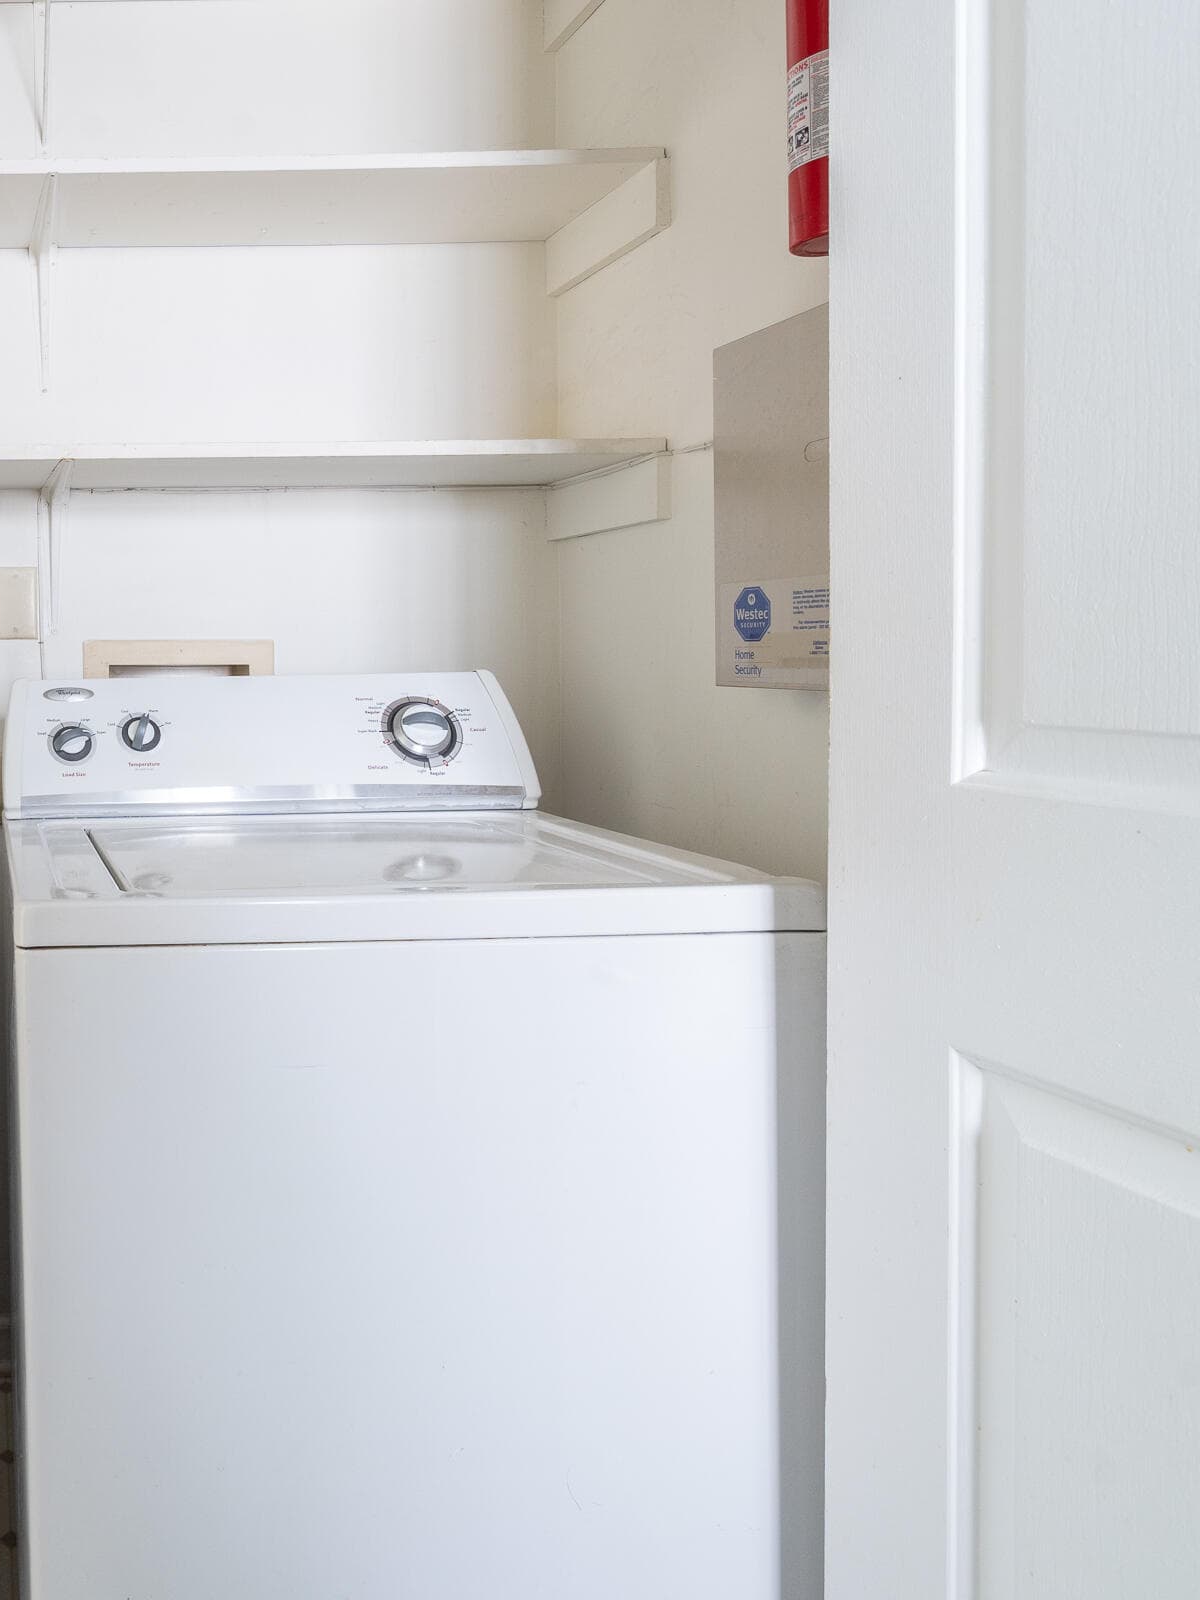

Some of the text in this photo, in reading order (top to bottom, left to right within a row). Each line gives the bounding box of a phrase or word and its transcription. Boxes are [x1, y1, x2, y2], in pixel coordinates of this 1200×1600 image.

[735, 608, 769, 620] Westec
[734, 649, 755, 660] Home
[734, 664, 762, 677] Security
